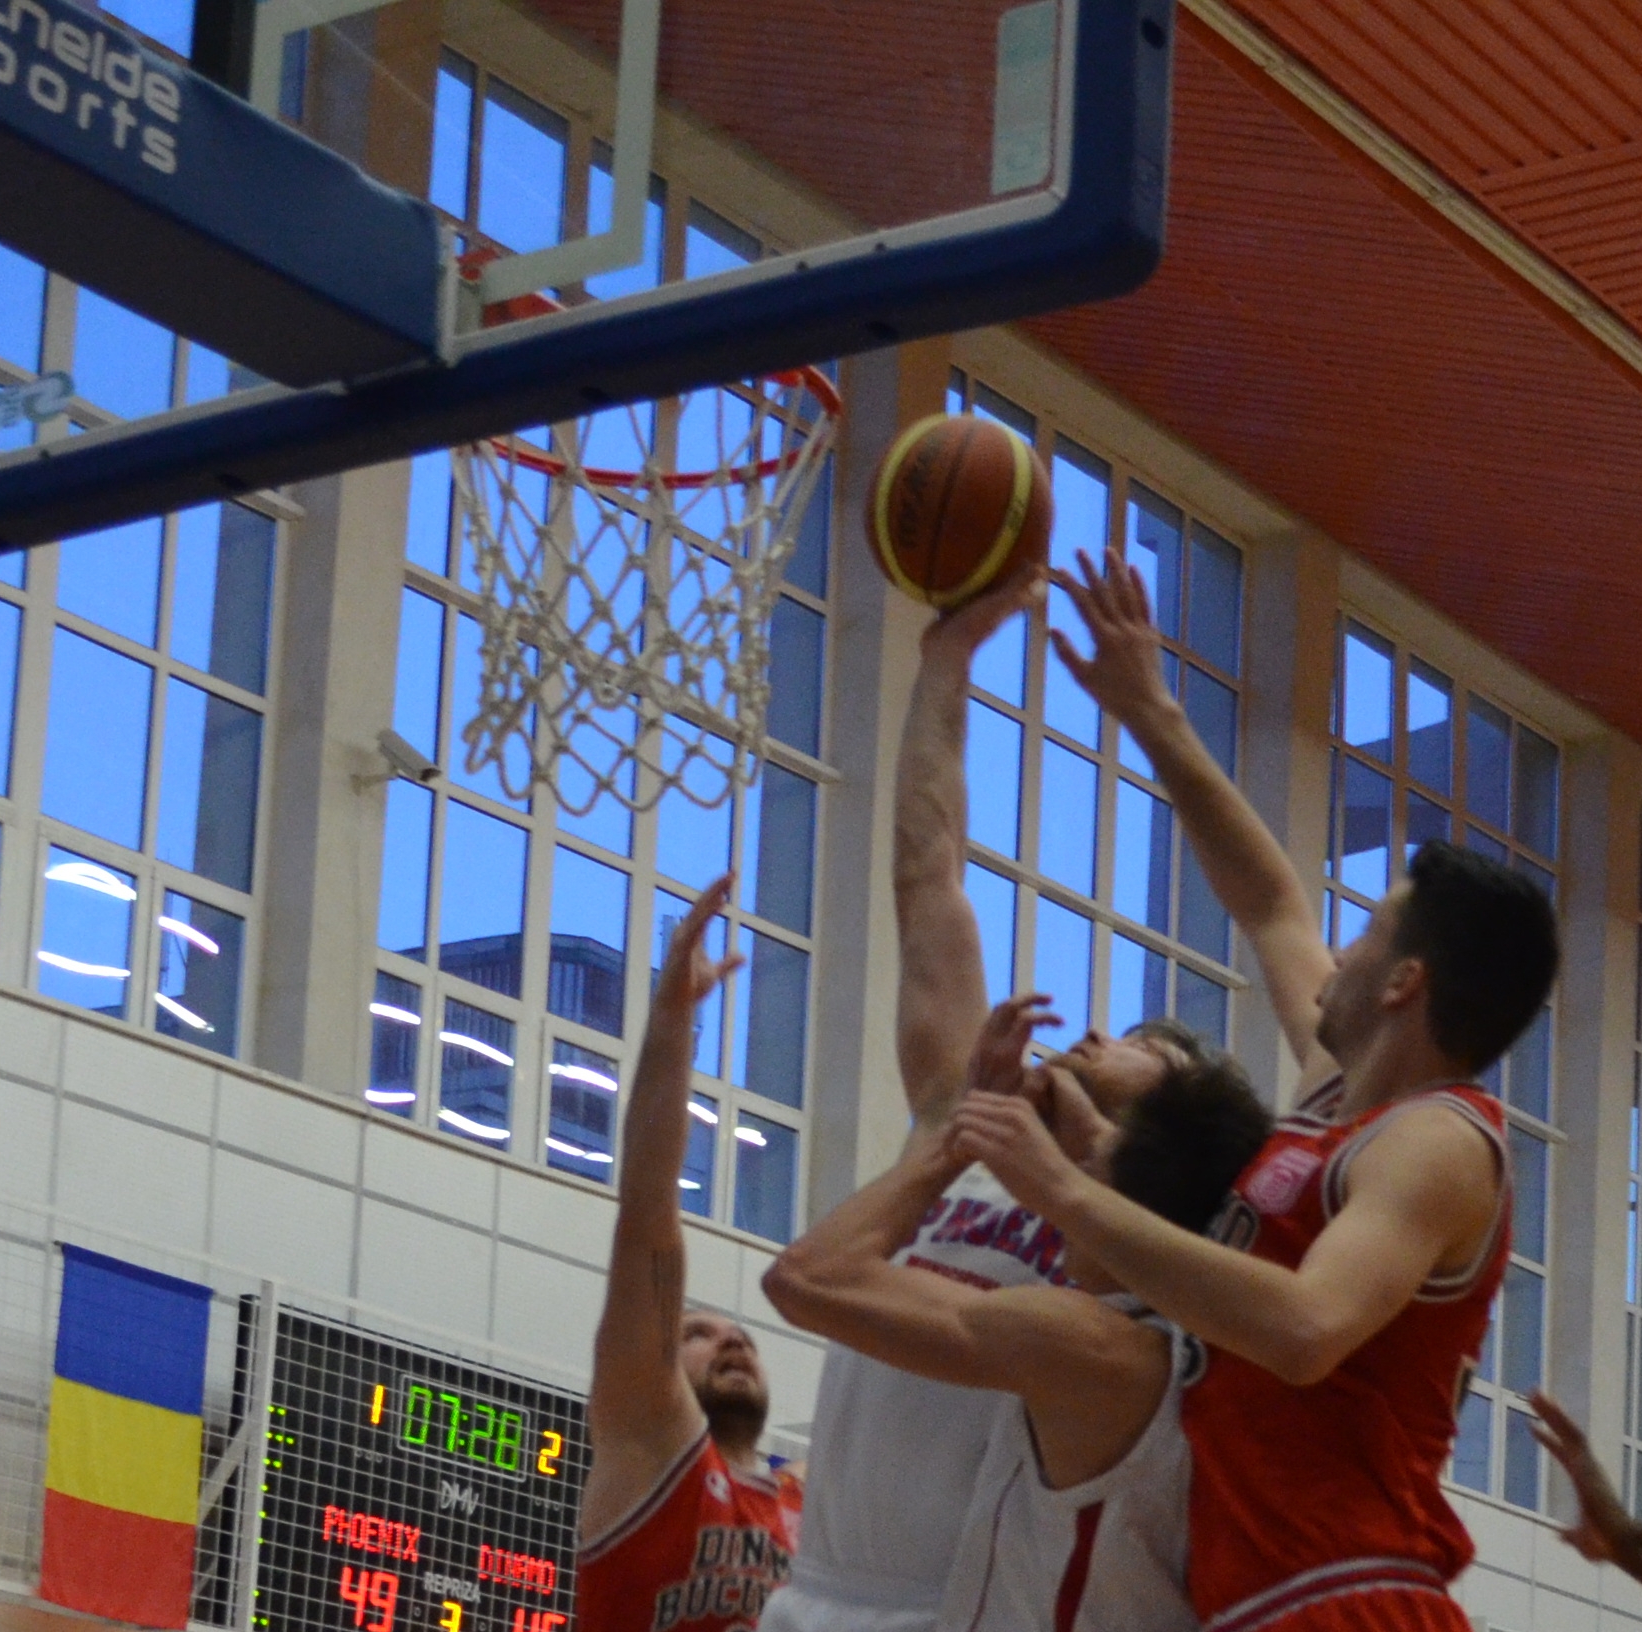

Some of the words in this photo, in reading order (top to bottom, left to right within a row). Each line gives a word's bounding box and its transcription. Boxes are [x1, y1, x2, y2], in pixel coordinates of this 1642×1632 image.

[371, 1384, 385, 1425] 1
[402, 1385, 522, 1472] 07:28
[537, 1430, 562, 1475] 2
[323, 1504, 421, 1563] PHOENIX
[477, 1544, 556, 1596] DINAMO
